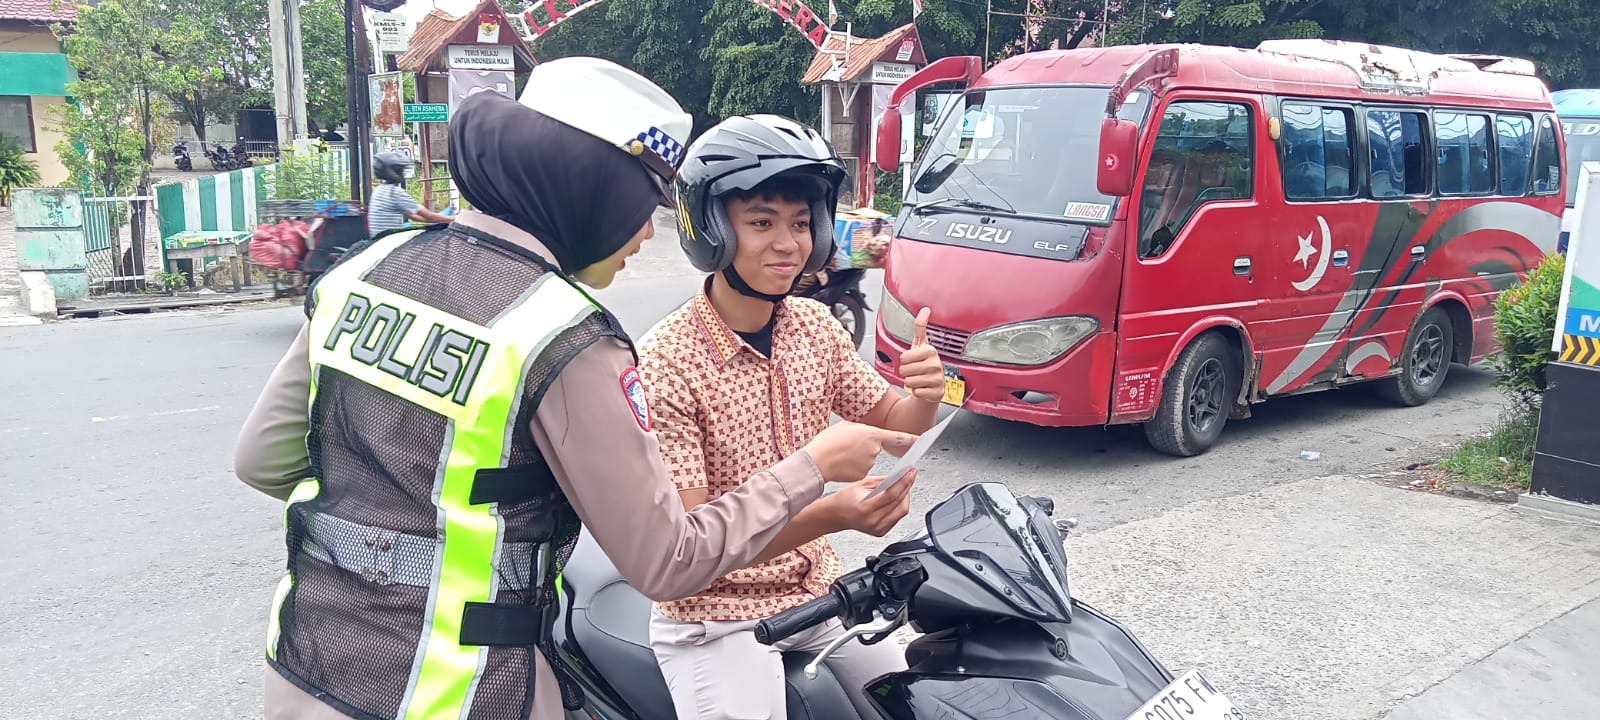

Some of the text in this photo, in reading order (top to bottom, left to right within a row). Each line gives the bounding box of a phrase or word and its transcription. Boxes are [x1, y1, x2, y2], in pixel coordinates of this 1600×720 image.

[1067, 203, 1107, 218] LANGSA
[946, 222, 1012, 244] ISUZU
[1033, 240, 1068, 252] ELF
[323, 292, 490, 407] POLISI
[1125, 373, 1151, 381] UMUM
